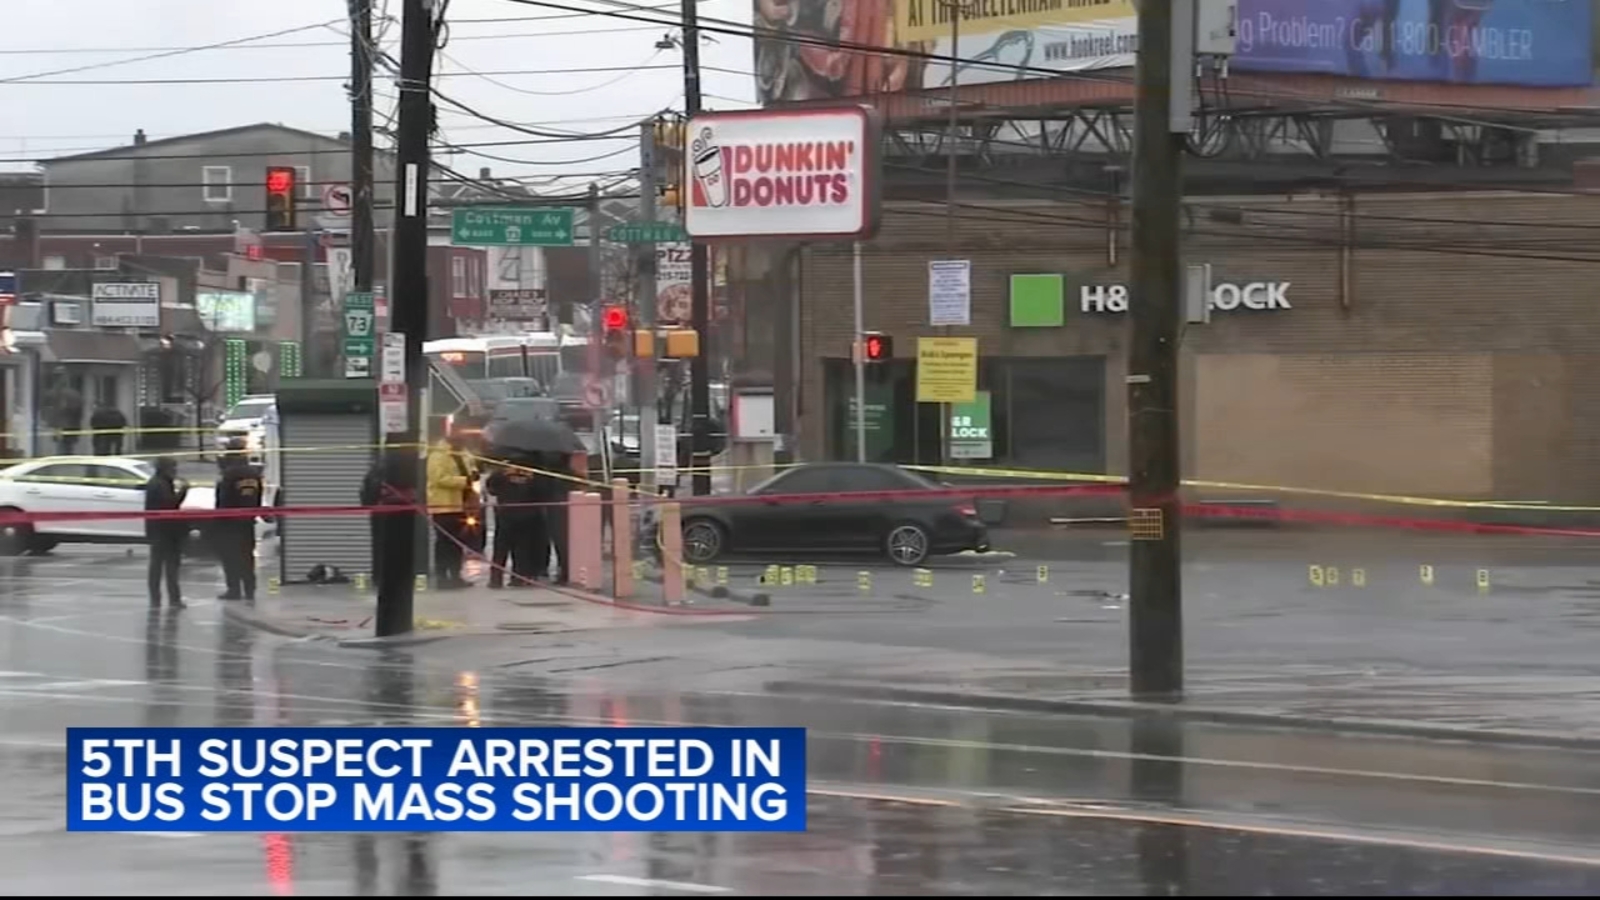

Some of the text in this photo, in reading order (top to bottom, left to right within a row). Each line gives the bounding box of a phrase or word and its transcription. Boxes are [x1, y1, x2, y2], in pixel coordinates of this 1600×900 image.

[1259, 11, 1345, 50] Problem?
[1350, 18, 1384, 53] Call
[1390, 22, 1532, 60] 1-800-GAMBLER
[734, 141, 854, 174] DUNKIN'
[734, 173, 849, 207] DONUTS
[542, 213, 561, 226] Av
[1207, 282, 1292, 310] OCK
[349, 316, 367, 332] 73
[951, 427, 988, 438] LOCK
